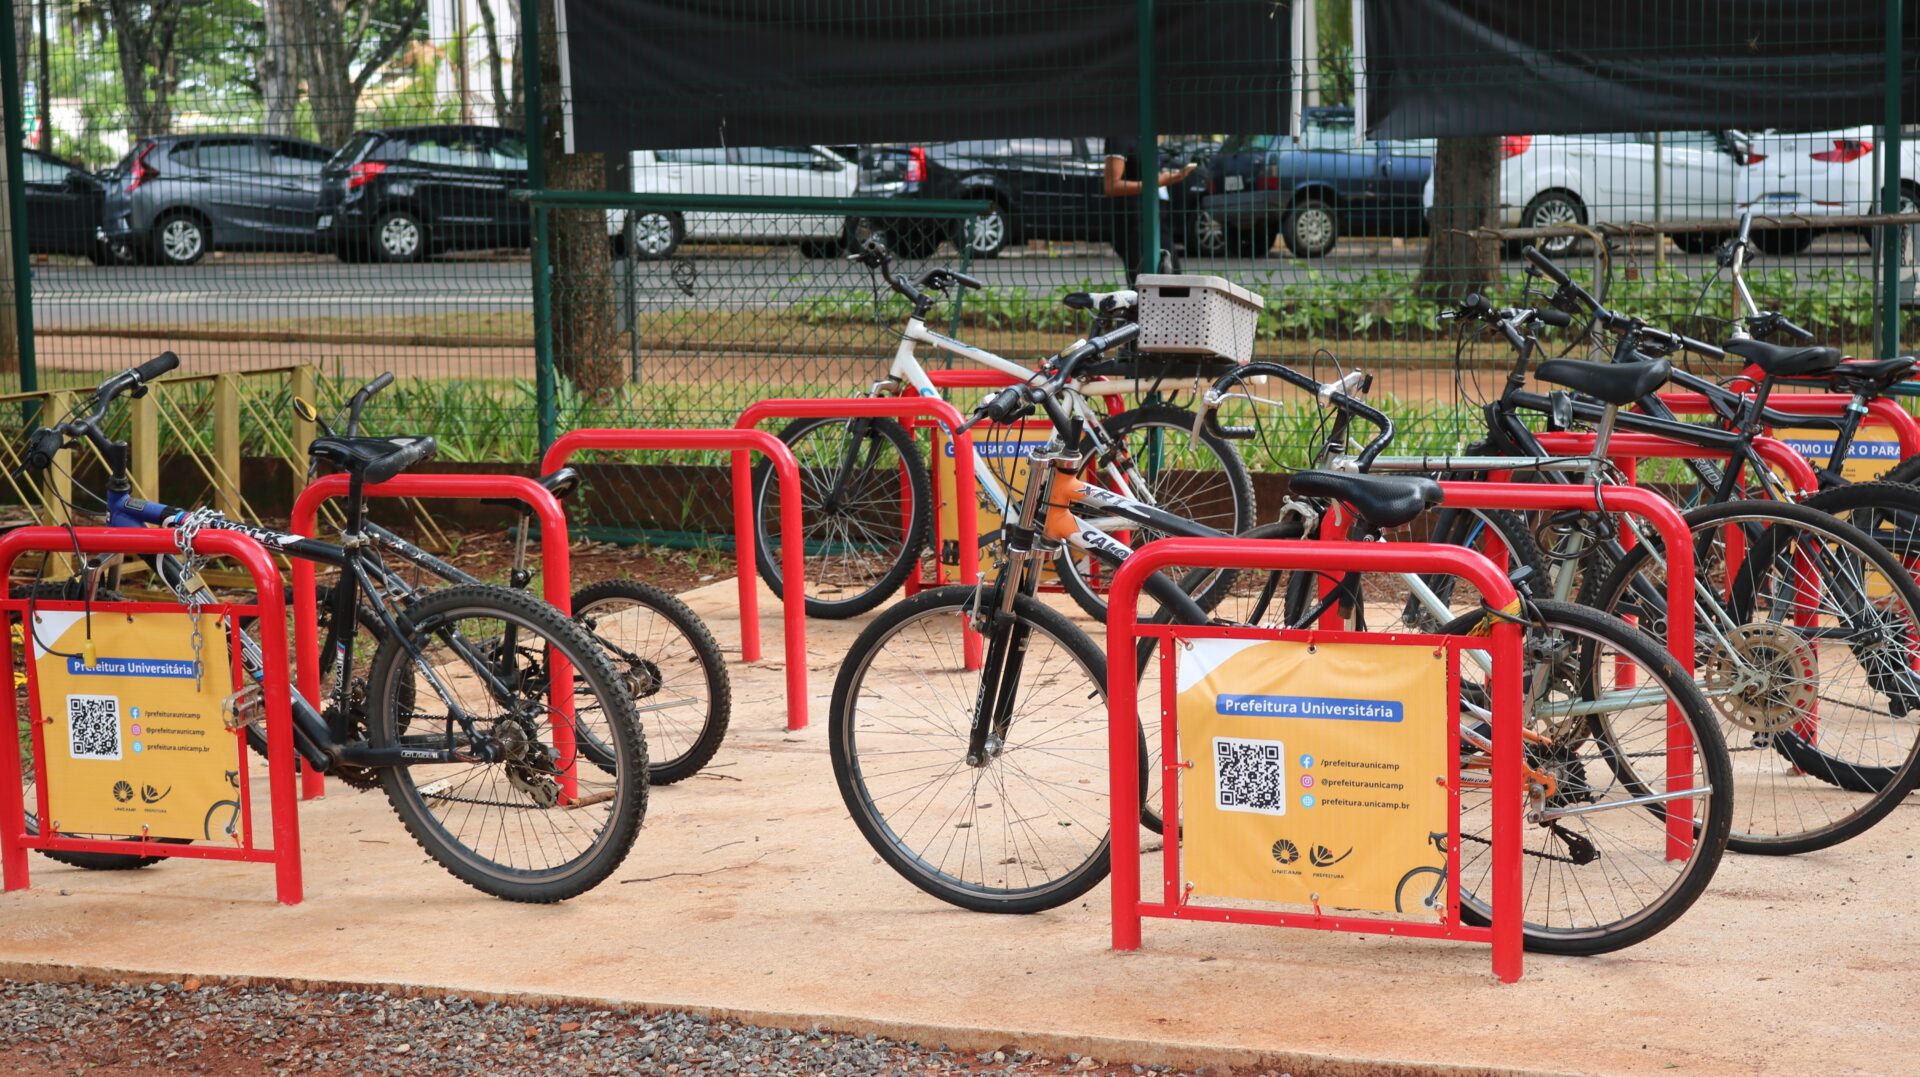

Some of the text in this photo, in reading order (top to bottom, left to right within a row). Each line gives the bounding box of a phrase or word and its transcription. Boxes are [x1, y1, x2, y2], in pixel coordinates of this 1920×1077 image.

[1007, 445, 1015, 454] O
[1788, 443, 1821, 455] OMO
[1825, 444, 1855, 455] UR
[1860, 444, 1868, 456] O
[127, 662, 193, 675] Universitária
[144, 710, 201, 720] /prefeituraunicamp
[1225, 699, 1393, 718] Prefeitura Universitária
[146, 727, 205, 736] @prefeituraunicamp
[147, 743, 210, 753] prefeitura.unicamp.br
[1320, 758, 1400, 771] /prefeituraunicamp
[1321, 777, 1404, 791] @prefeituraunicamp
[1321, 798, 1411, 811] prefeitura.unicamp.br
